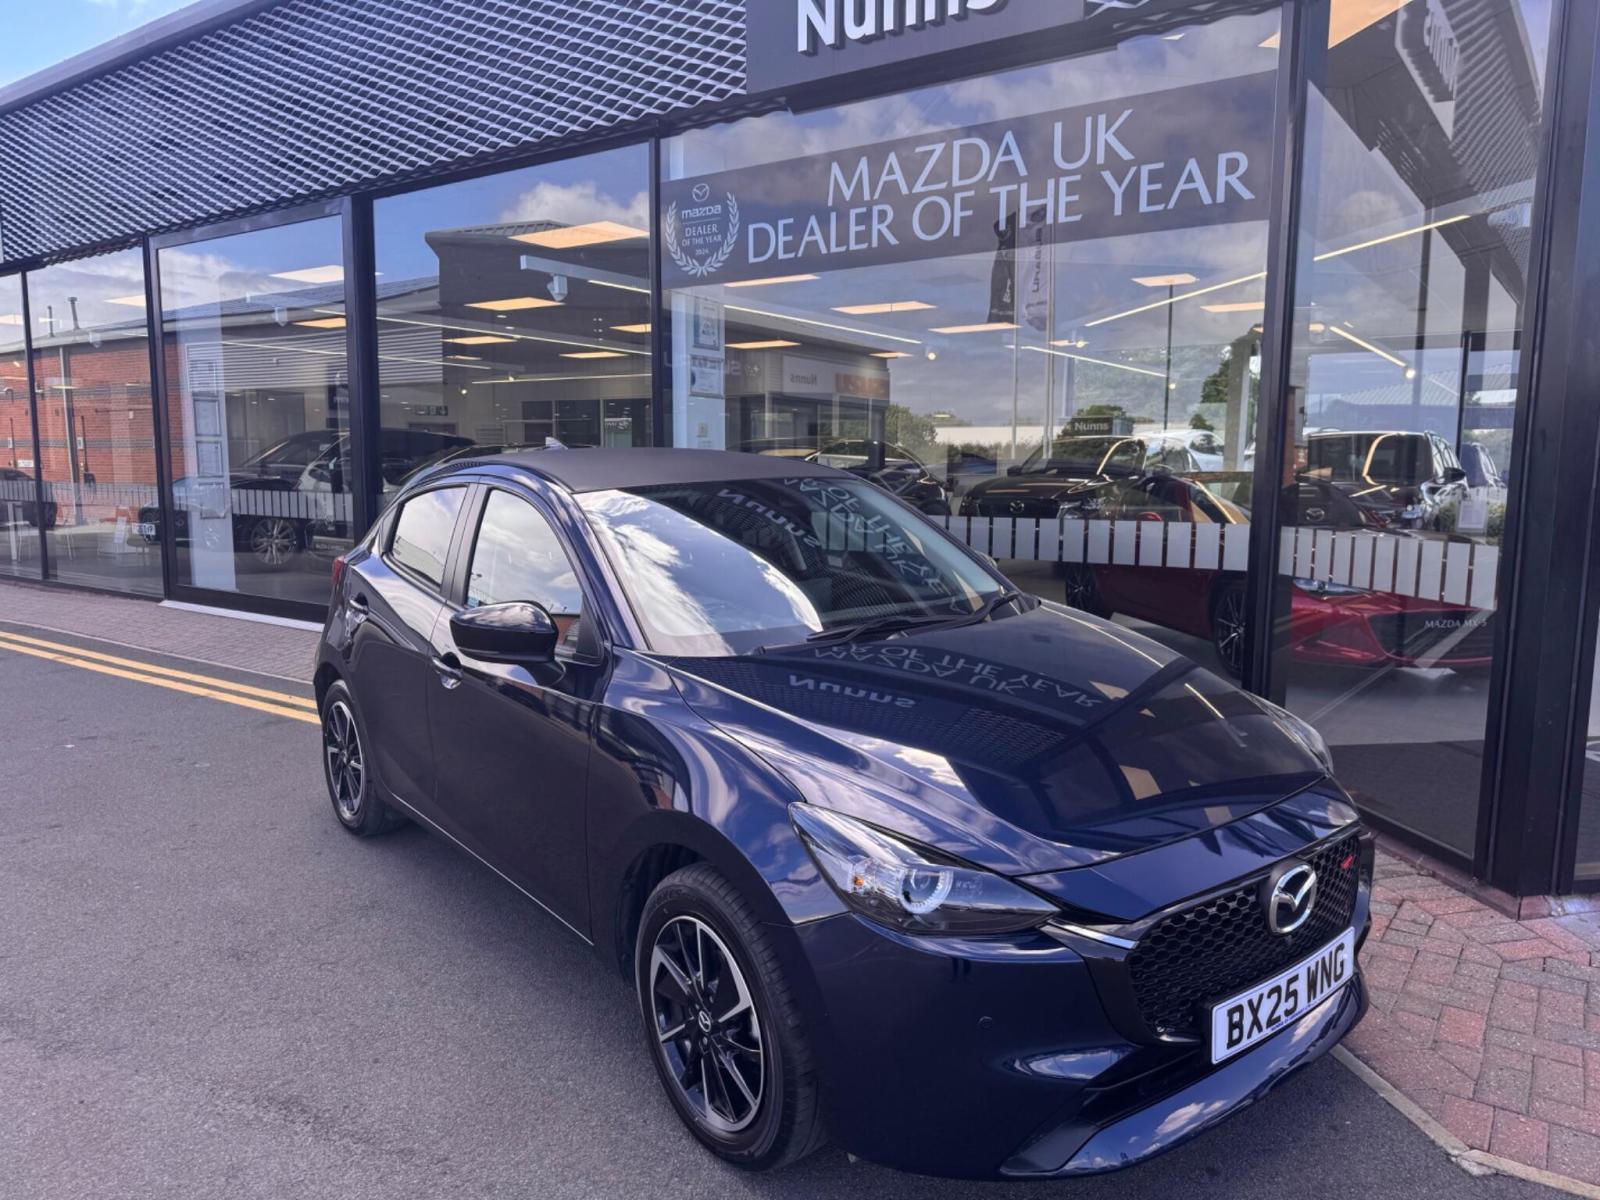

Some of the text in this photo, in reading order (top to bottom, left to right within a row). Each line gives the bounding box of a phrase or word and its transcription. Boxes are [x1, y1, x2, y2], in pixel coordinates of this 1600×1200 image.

[827, 108, 1136, 207] MAZDA UK
[681, 204, 722, 220] mazda
[747, 150, 1256, 264] DEALER OF THE YEAR
[685, 223, 719, 238] DEALER
[705, 234, 722, 244] YEAR
[1074, 421, 1110, 431] Nunns
[1424, 620, 1461, 629] MAZDA
[1226, 973, 1300, 1050] BX25
[1306, 942, 1345, 1004] WNG
